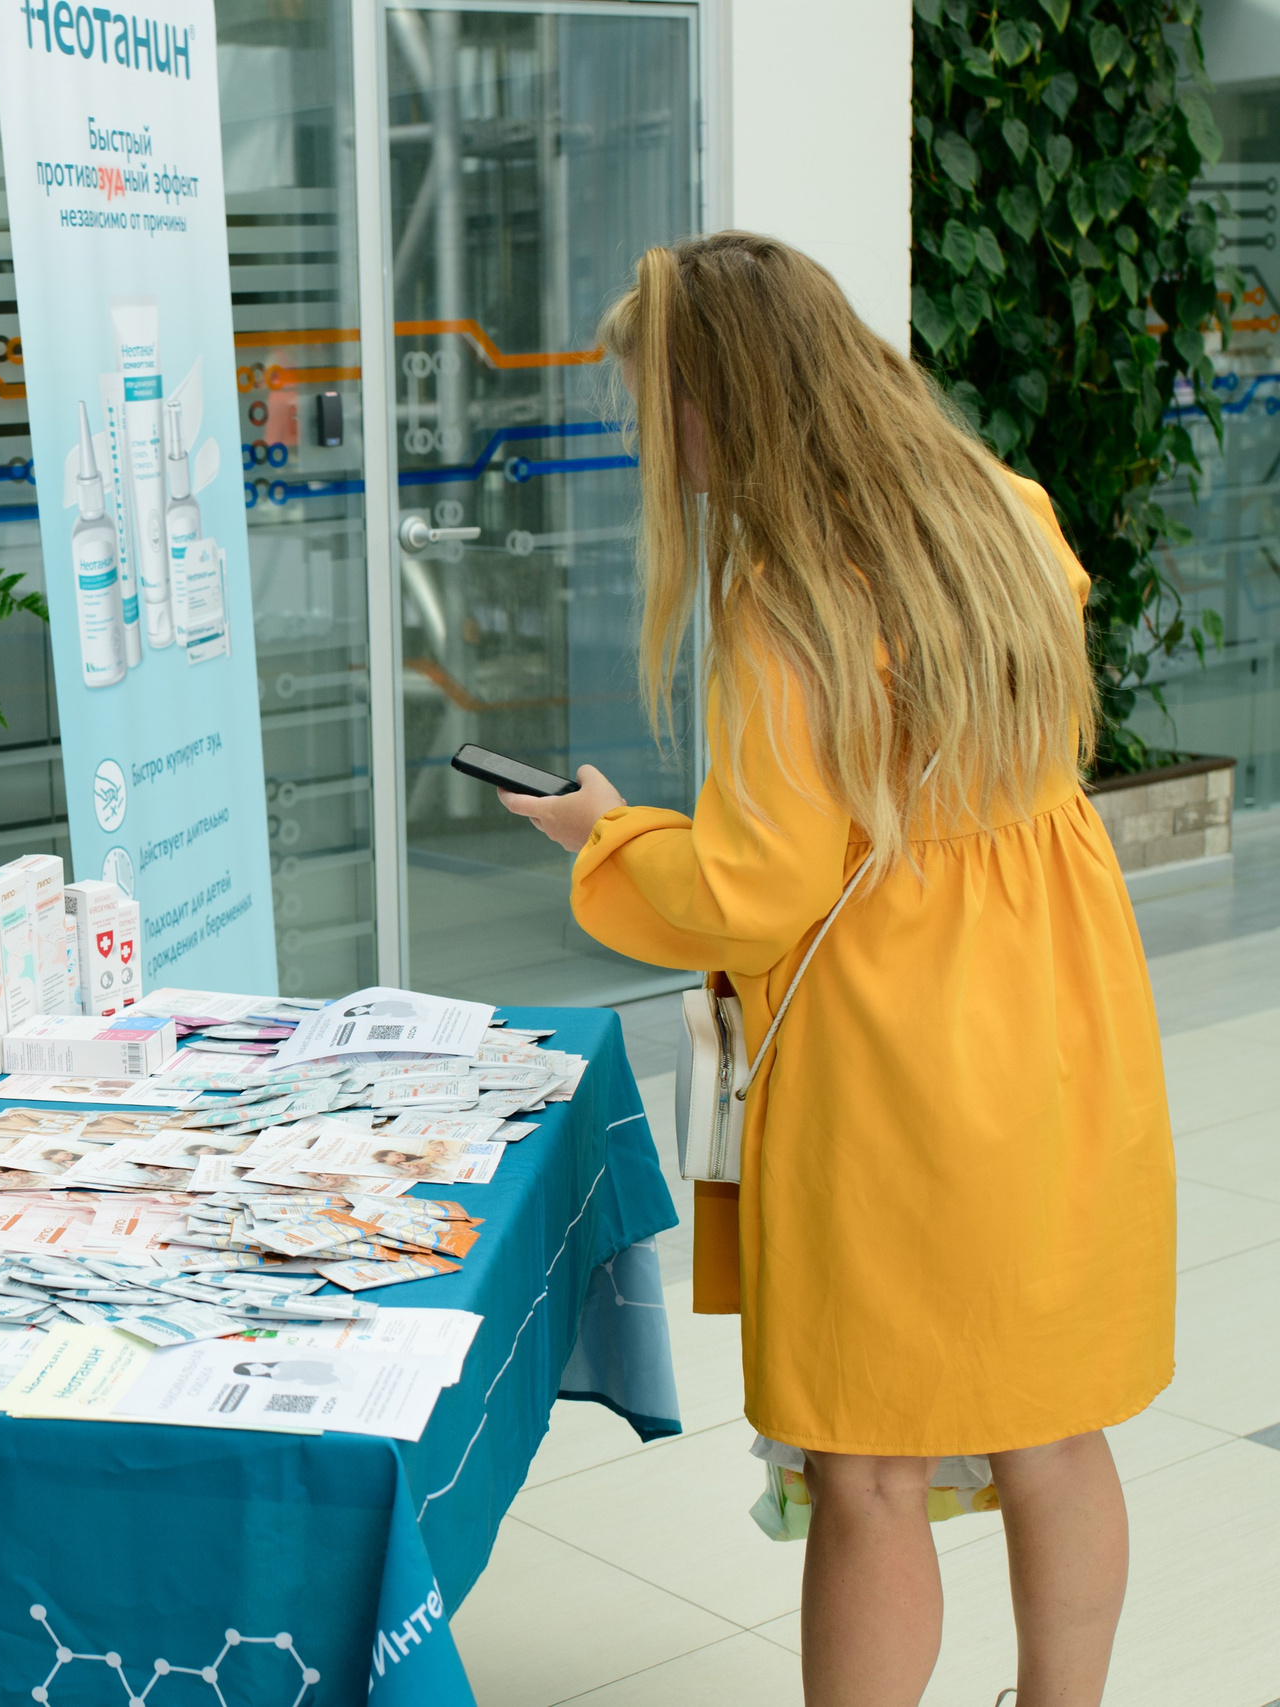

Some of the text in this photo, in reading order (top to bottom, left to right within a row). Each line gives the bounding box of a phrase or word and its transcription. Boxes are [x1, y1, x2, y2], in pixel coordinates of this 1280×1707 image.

[21, 0, 190, 80] Неотанин
[88, 117, 152, 163] Быстрый
[37, 161, 199, 205] противозудный эффект
[60, 209, 187, 238] независимо от причины
[132, 732, 222, 787] Быстро купирует зуд
[139, 808, 229, 874] Действует длительно
[119, 917, 136, 928] OXYNOL
[144, 870, 232, 942] Подходит для детей
[153, 932, 198, 976] рождения
[205, 894, 253, 937] беременных
[53, 1345, 105, 1399] Неотанин
[372, 1574, 445, 1678] Инте
